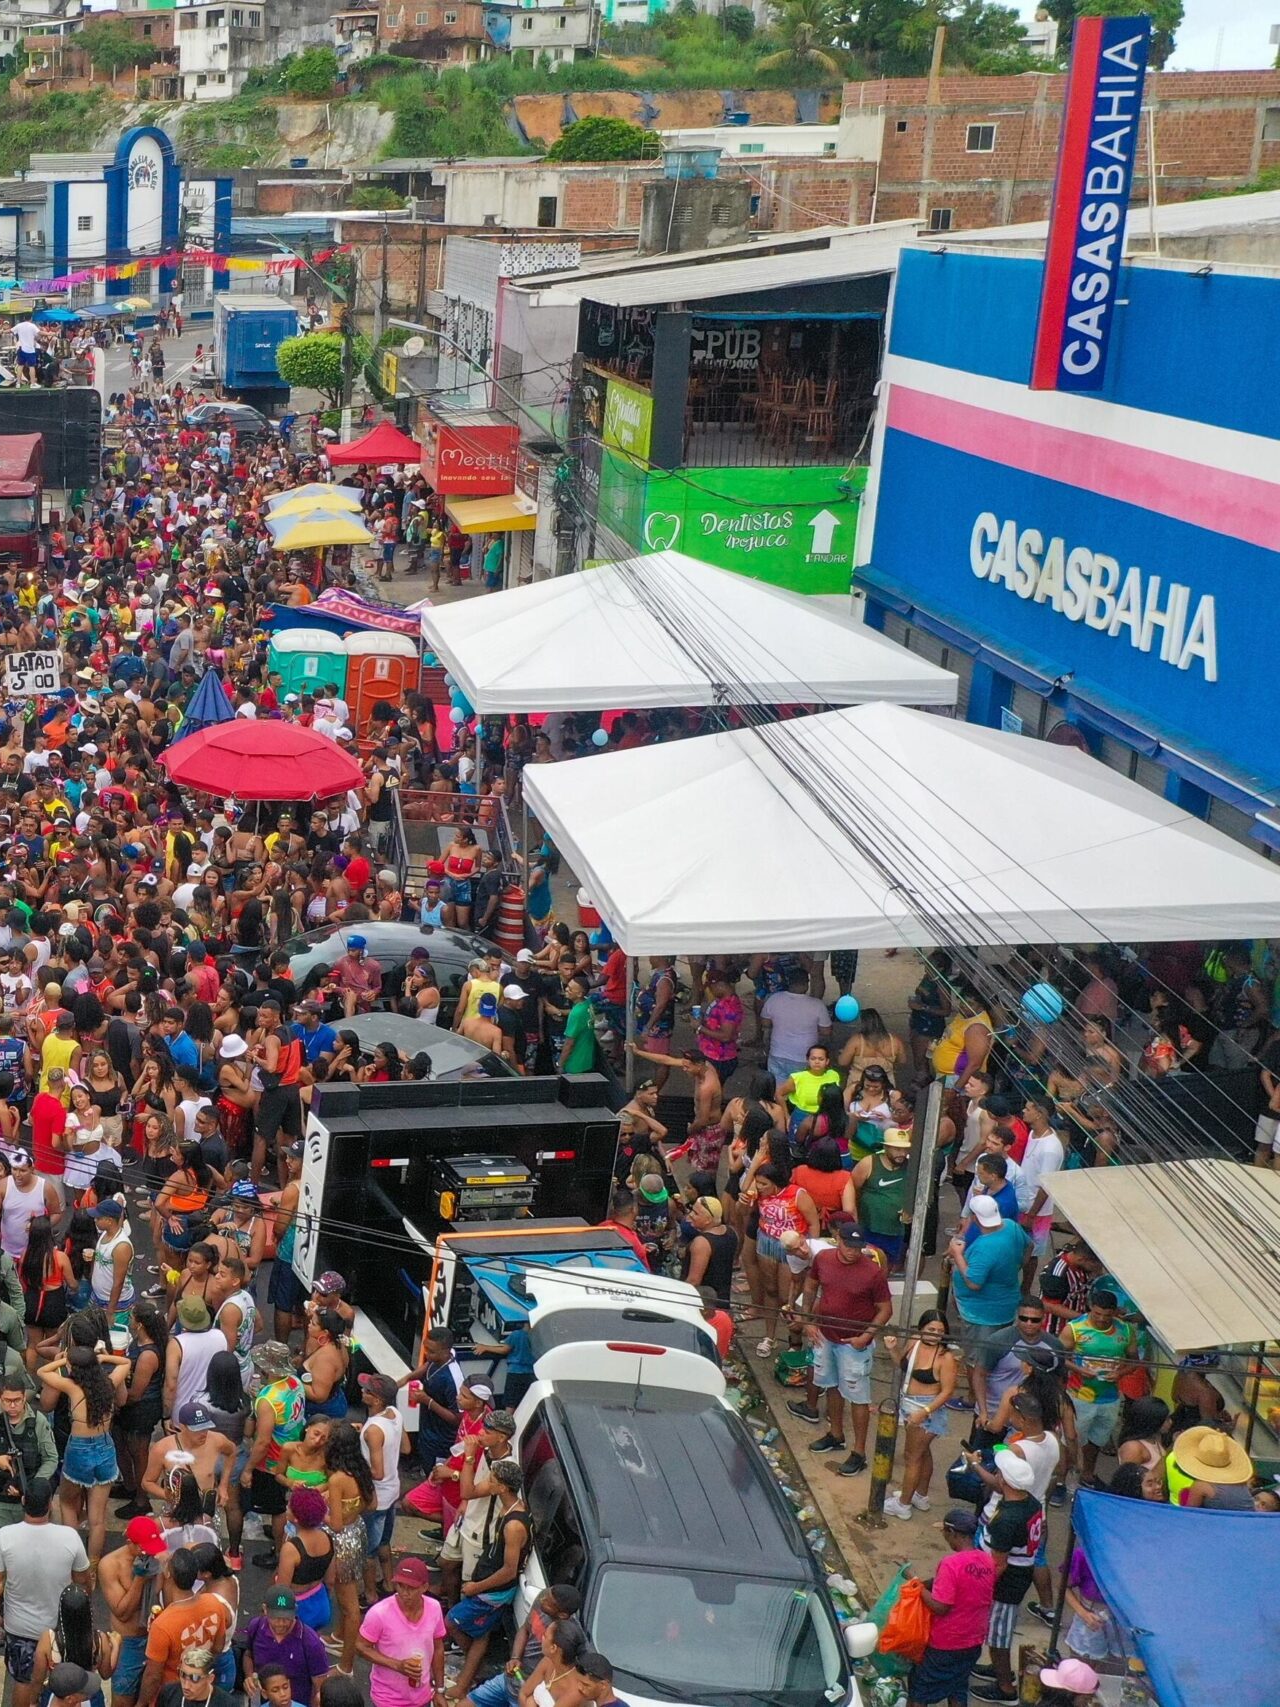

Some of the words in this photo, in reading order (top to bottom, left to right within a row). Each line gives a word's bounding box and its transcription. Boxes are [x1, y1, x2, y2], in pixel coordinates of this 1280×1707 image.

[1062, 34, 1142, 375] CASASBAHIA
[701, 511, 794, 536] Dentistas
[970, 512, 1218, 683] CASASBAHIA
